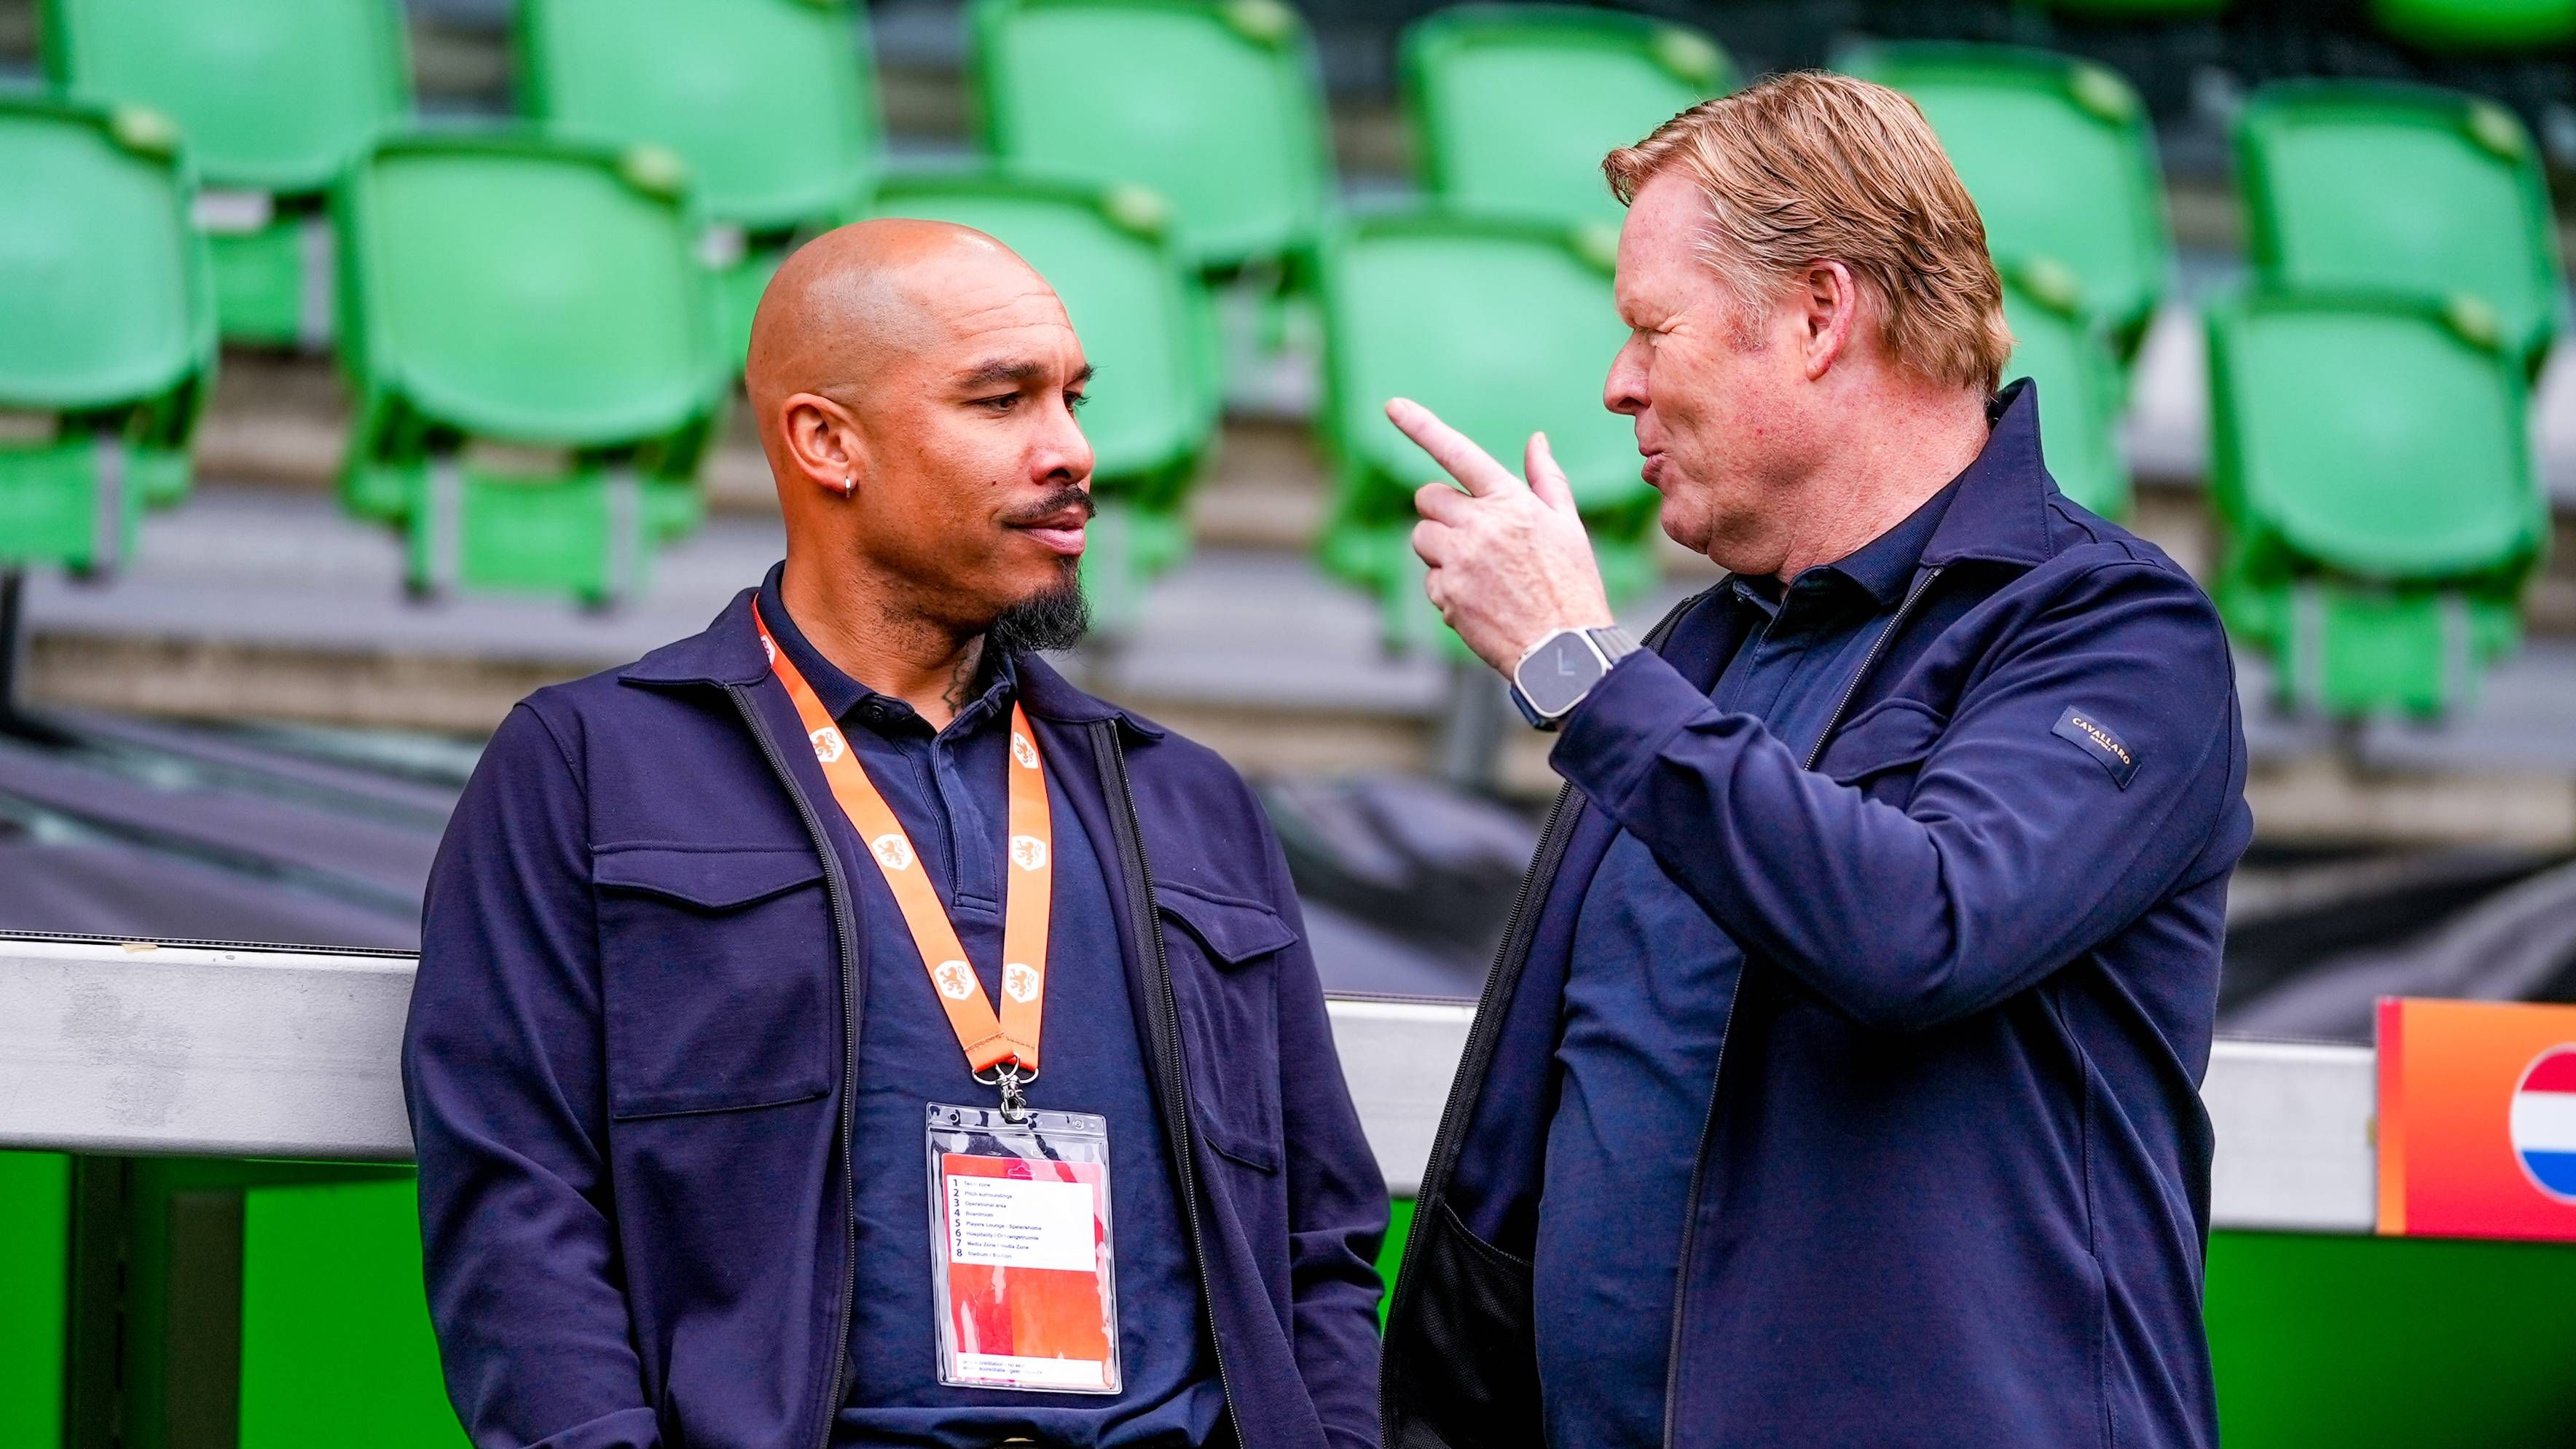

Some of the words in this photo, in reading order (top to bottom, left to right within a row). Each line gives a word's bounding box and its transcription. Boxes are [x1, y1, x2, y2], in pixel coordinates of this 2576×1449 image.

[2072, 717, 2131, 765] CAVALLARO
[953, 1179, 958, 1187] 1
[954, 1189, 959, 1197] 2
[954, 1198, 959, 1206] 3
[954, 1209, 960, 1217] 4
[955, 1219, 960, 1227] 5
[955, 1229, 962, 1237] 6
[956, 1238, 962, 1246] 7
[957, 1249, 962, 1257] 8
